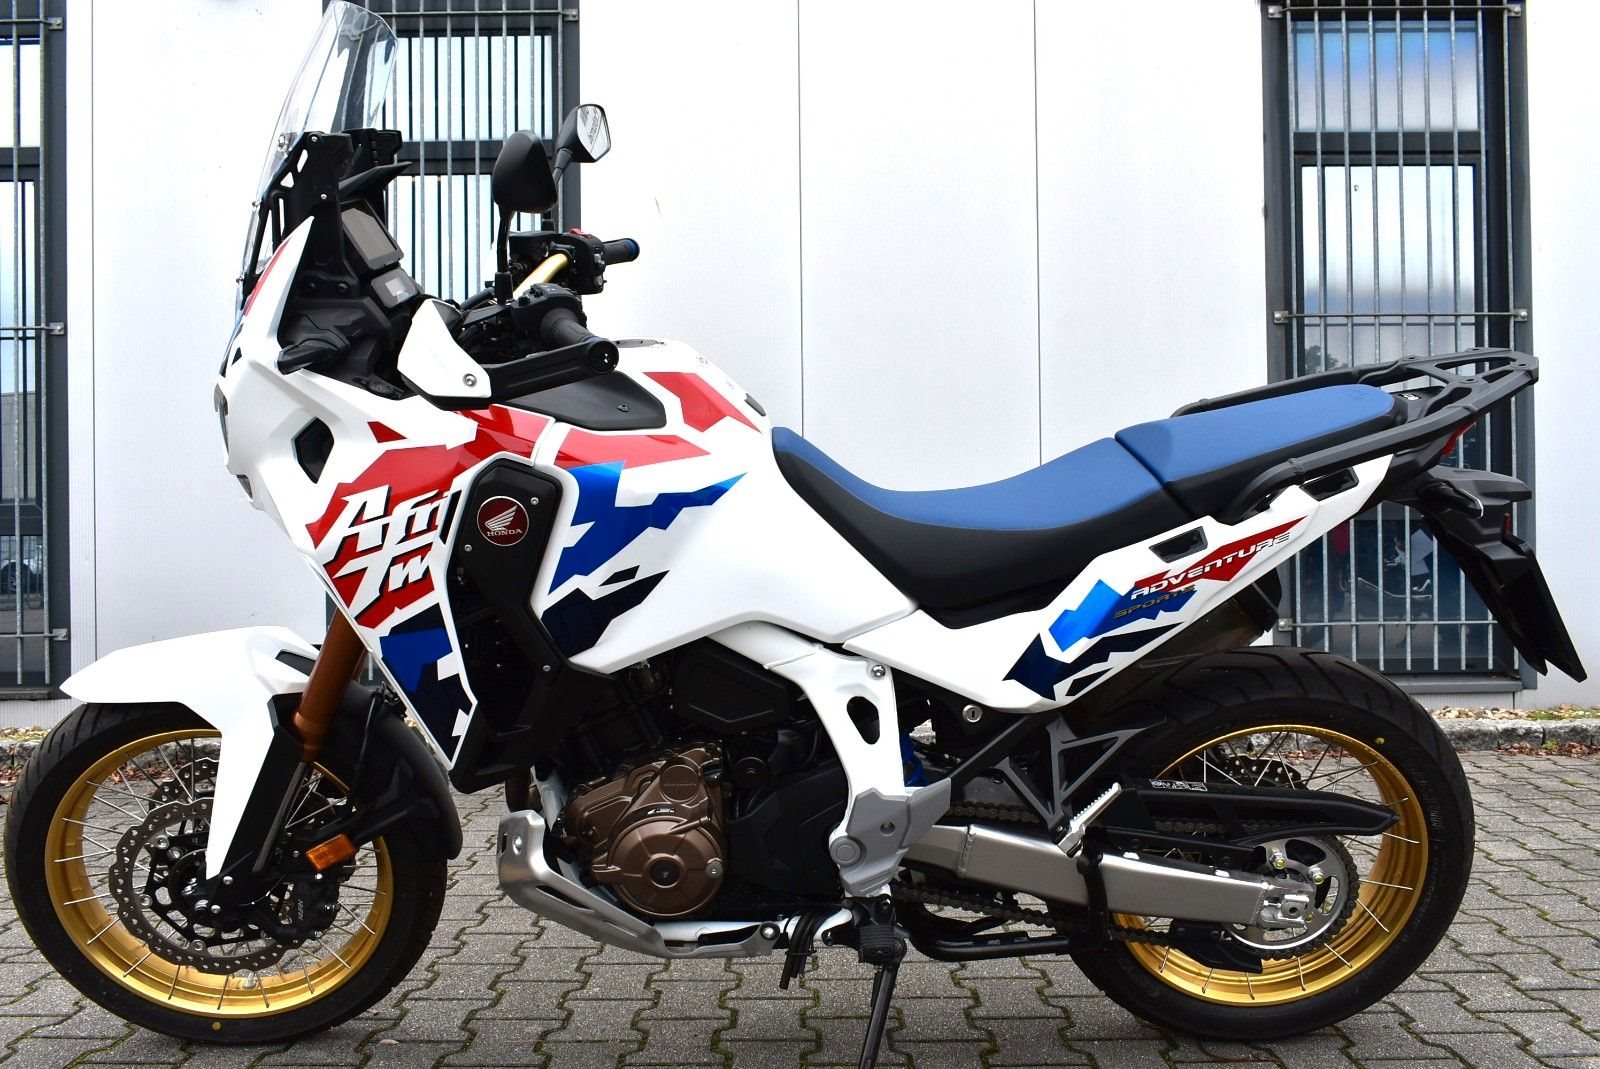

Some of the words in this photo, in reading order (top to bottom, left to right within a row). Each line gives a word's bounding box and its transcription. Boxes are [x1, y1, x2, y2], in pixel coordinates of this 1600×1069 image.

[486, 529, 523, 537] HONDA
[1131, 532, 1290, 600] ADVENTURE
[1114, 584, 1196, 618] SPORTS
